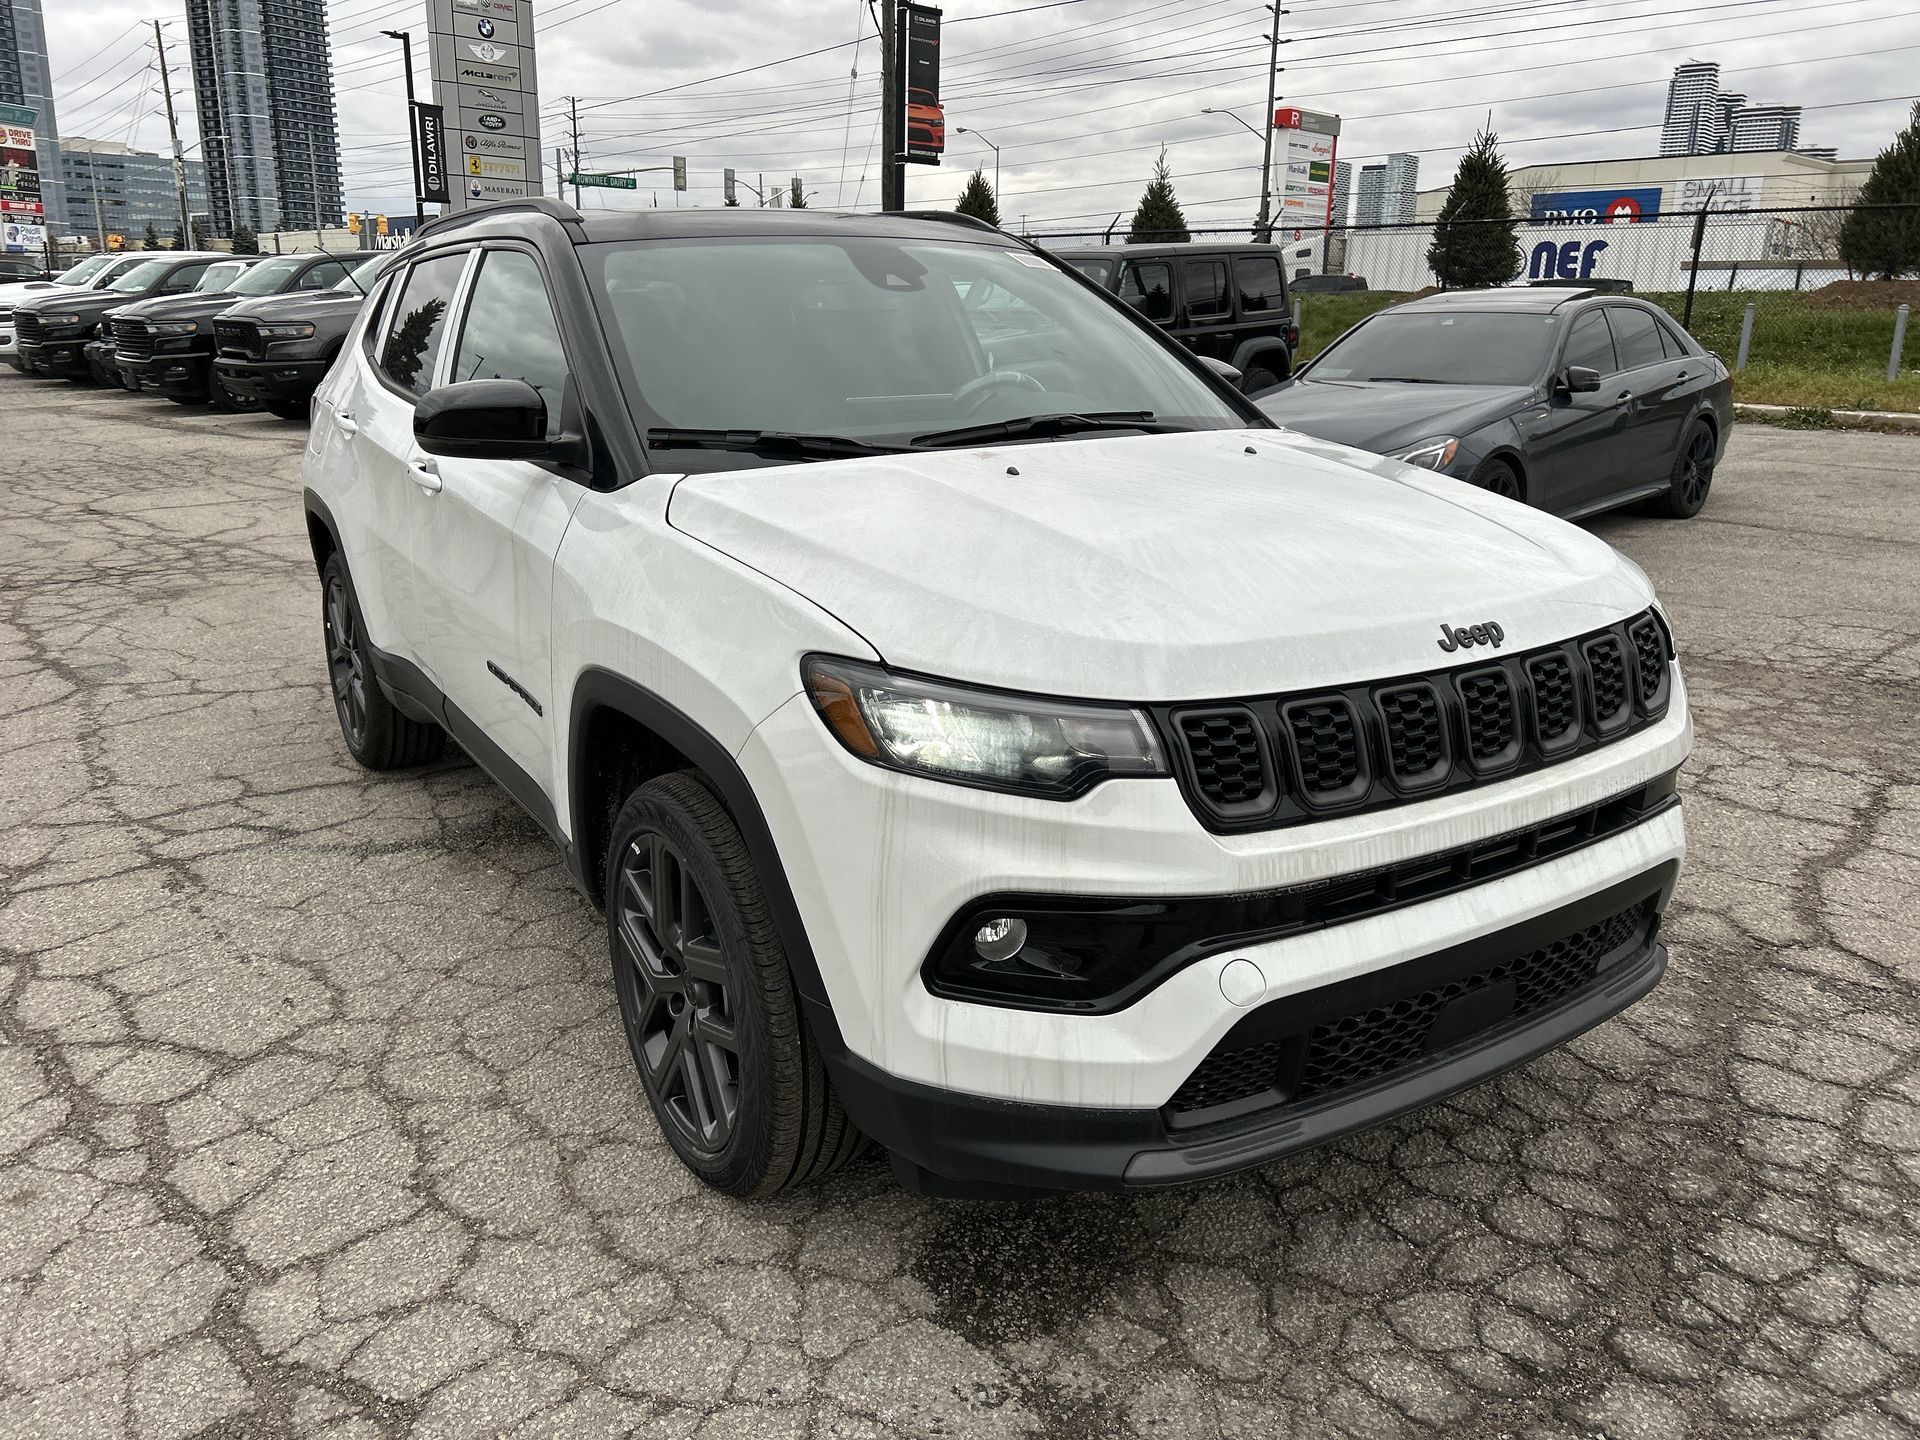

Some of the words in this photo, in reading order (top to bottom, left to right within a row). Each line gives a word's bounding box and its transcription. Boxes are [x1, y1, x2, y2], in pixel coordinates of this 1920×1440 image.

[493, 3, 513, 12] GMC
[460, 69, 512, 82] McLaren
[475, 102, 507, 110] JAGUAR
[483, 115, 498, 123] LAND
[1290, 111, 1300, 125] R
[8, 128, 32, 139] DRIVE
[11, 137, 31, 146] THRU
[424, 116, 438, 175] DILAWRI
[480, 139, 498, 150] Alfa
[498, 140, 523, 150] Romeo
[576, 175, 608, 186] ROWNTREE
[610, 178, 627, 187] DAIRY
[484, 186, 523, 195] MASERATI
[1682, 178, 1752, 198] SMALL
[374, 227, 413, 250] Marshall
[1437, 620, 1505, 653] Jeep
